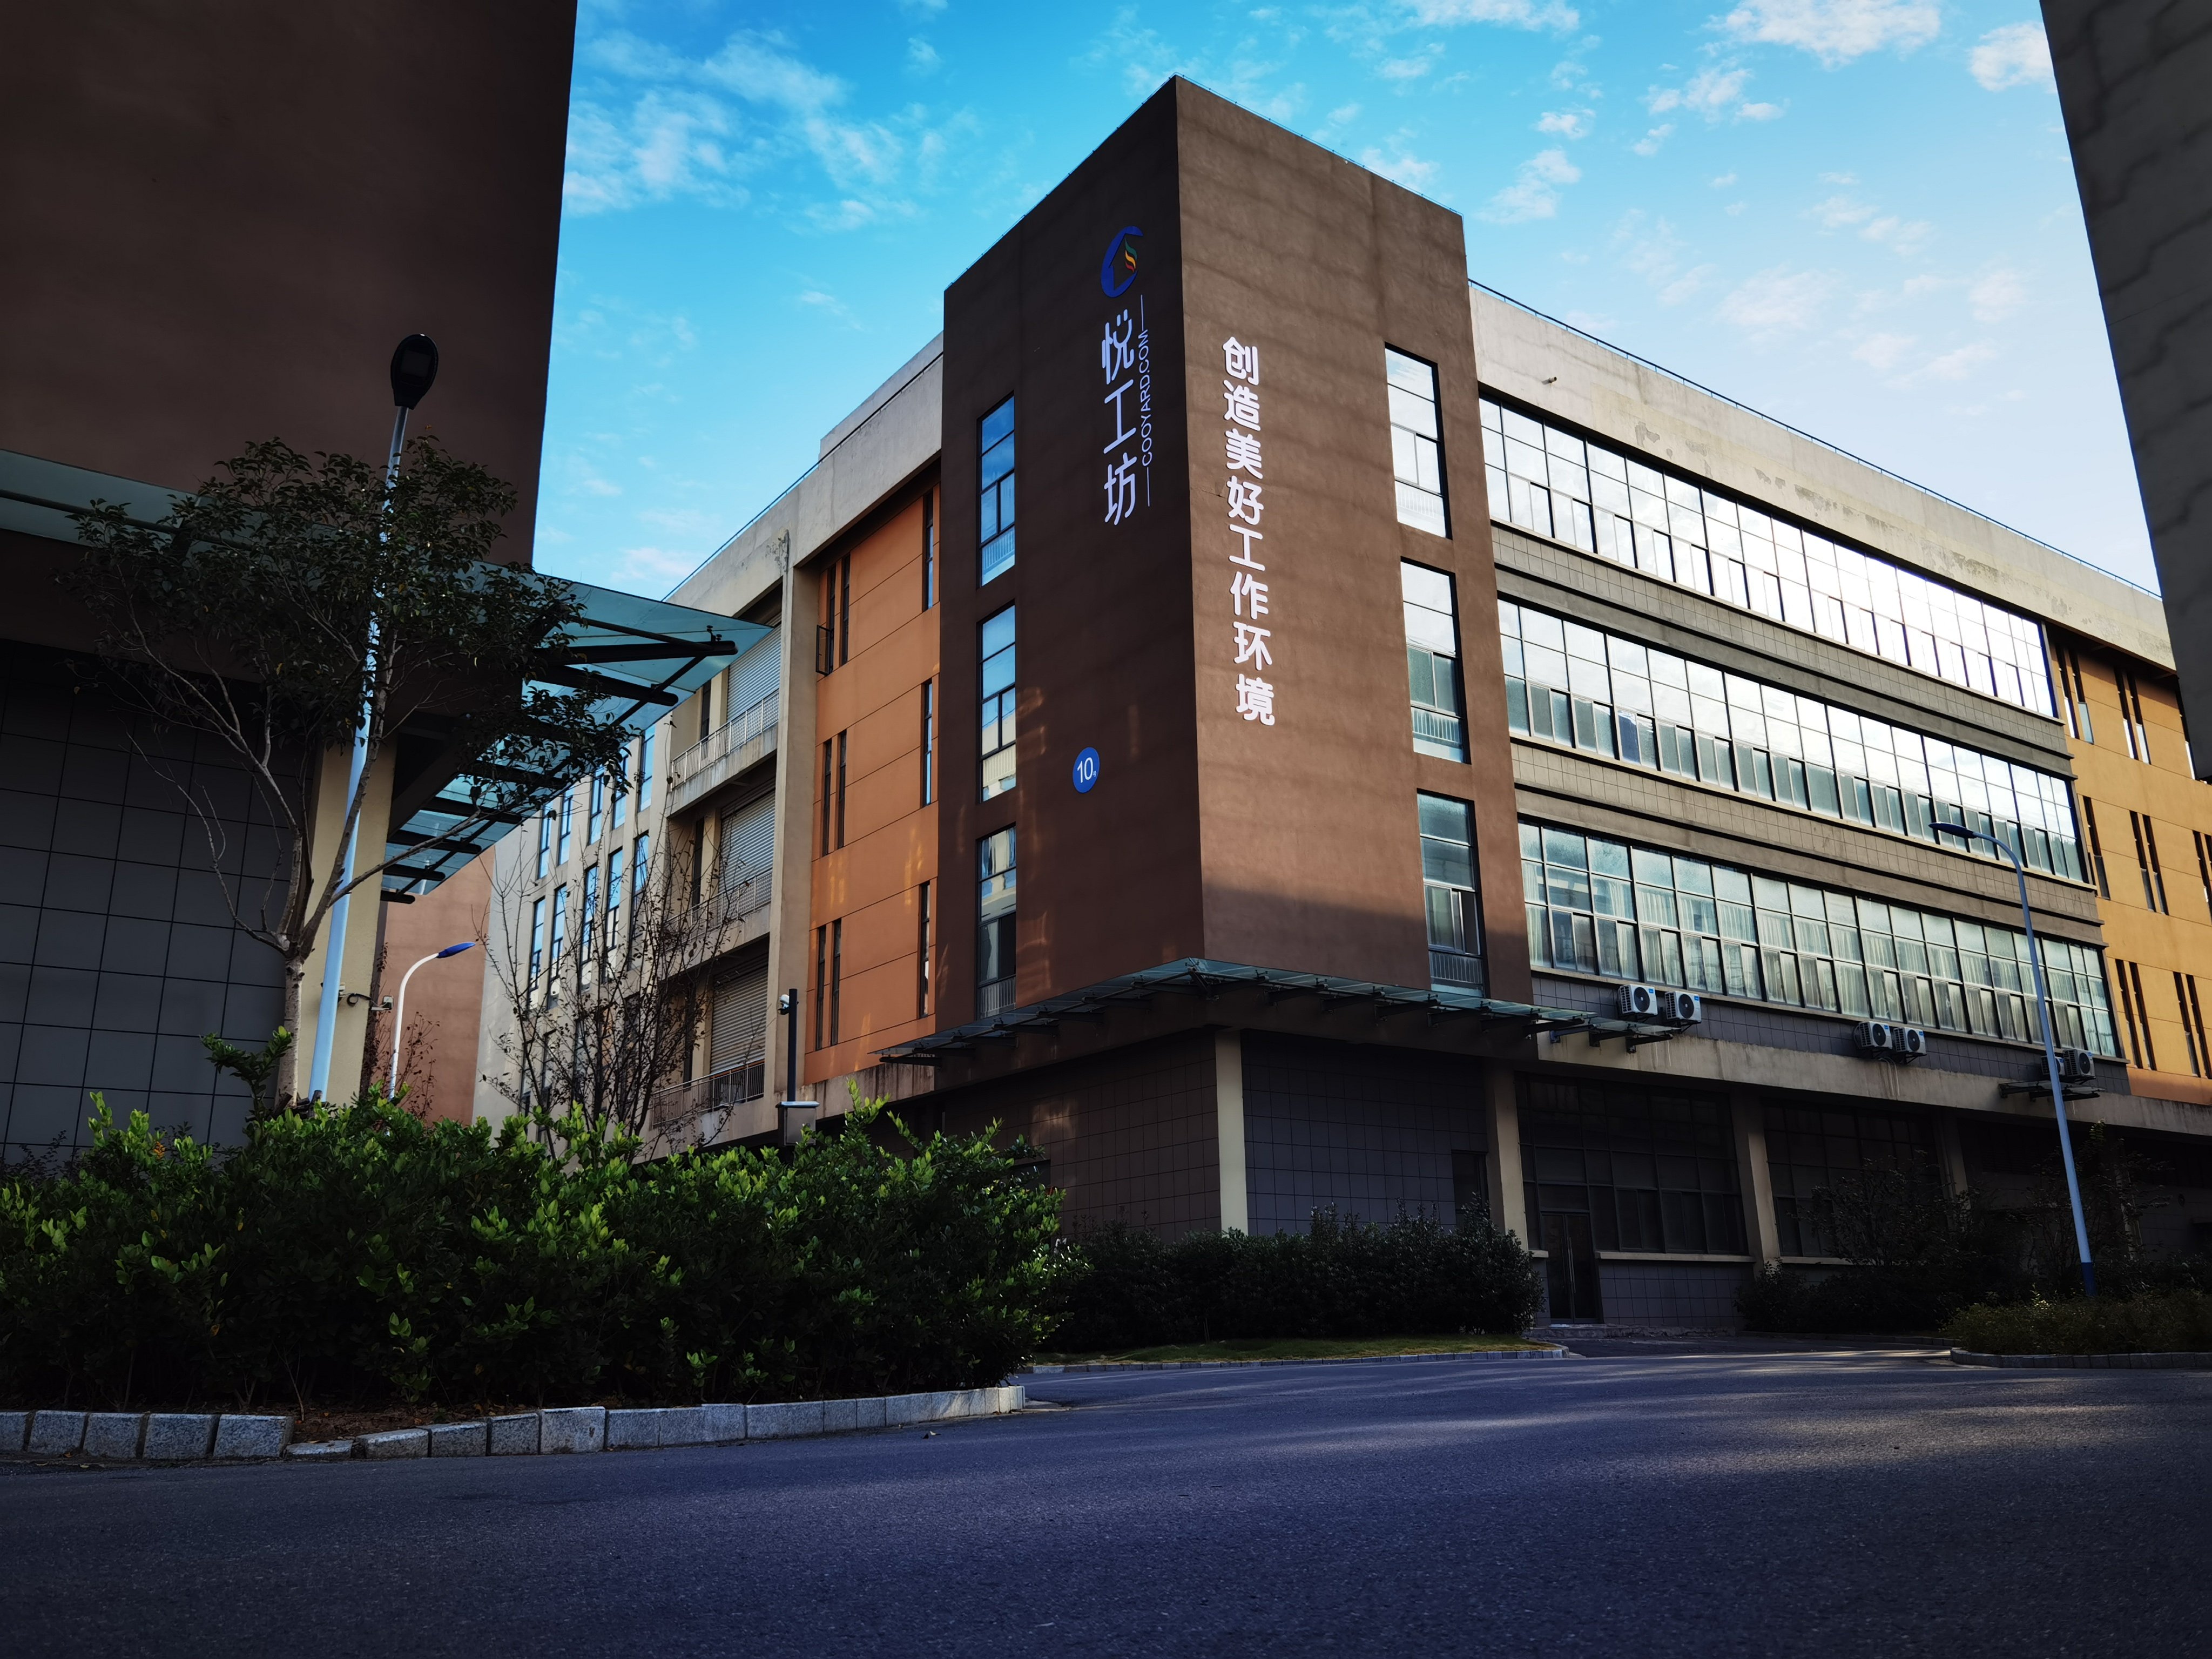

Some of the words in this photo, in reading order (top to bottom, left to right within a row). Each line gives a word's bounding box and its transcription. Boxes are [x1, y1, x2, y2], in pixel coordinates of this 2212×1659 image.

[1102, 309, 1137, 525] 悦工坊
[1138, 329, 1153, 467] COOYARD.COM
[1223, 336, 1275, 726] 创造美好工作环境
